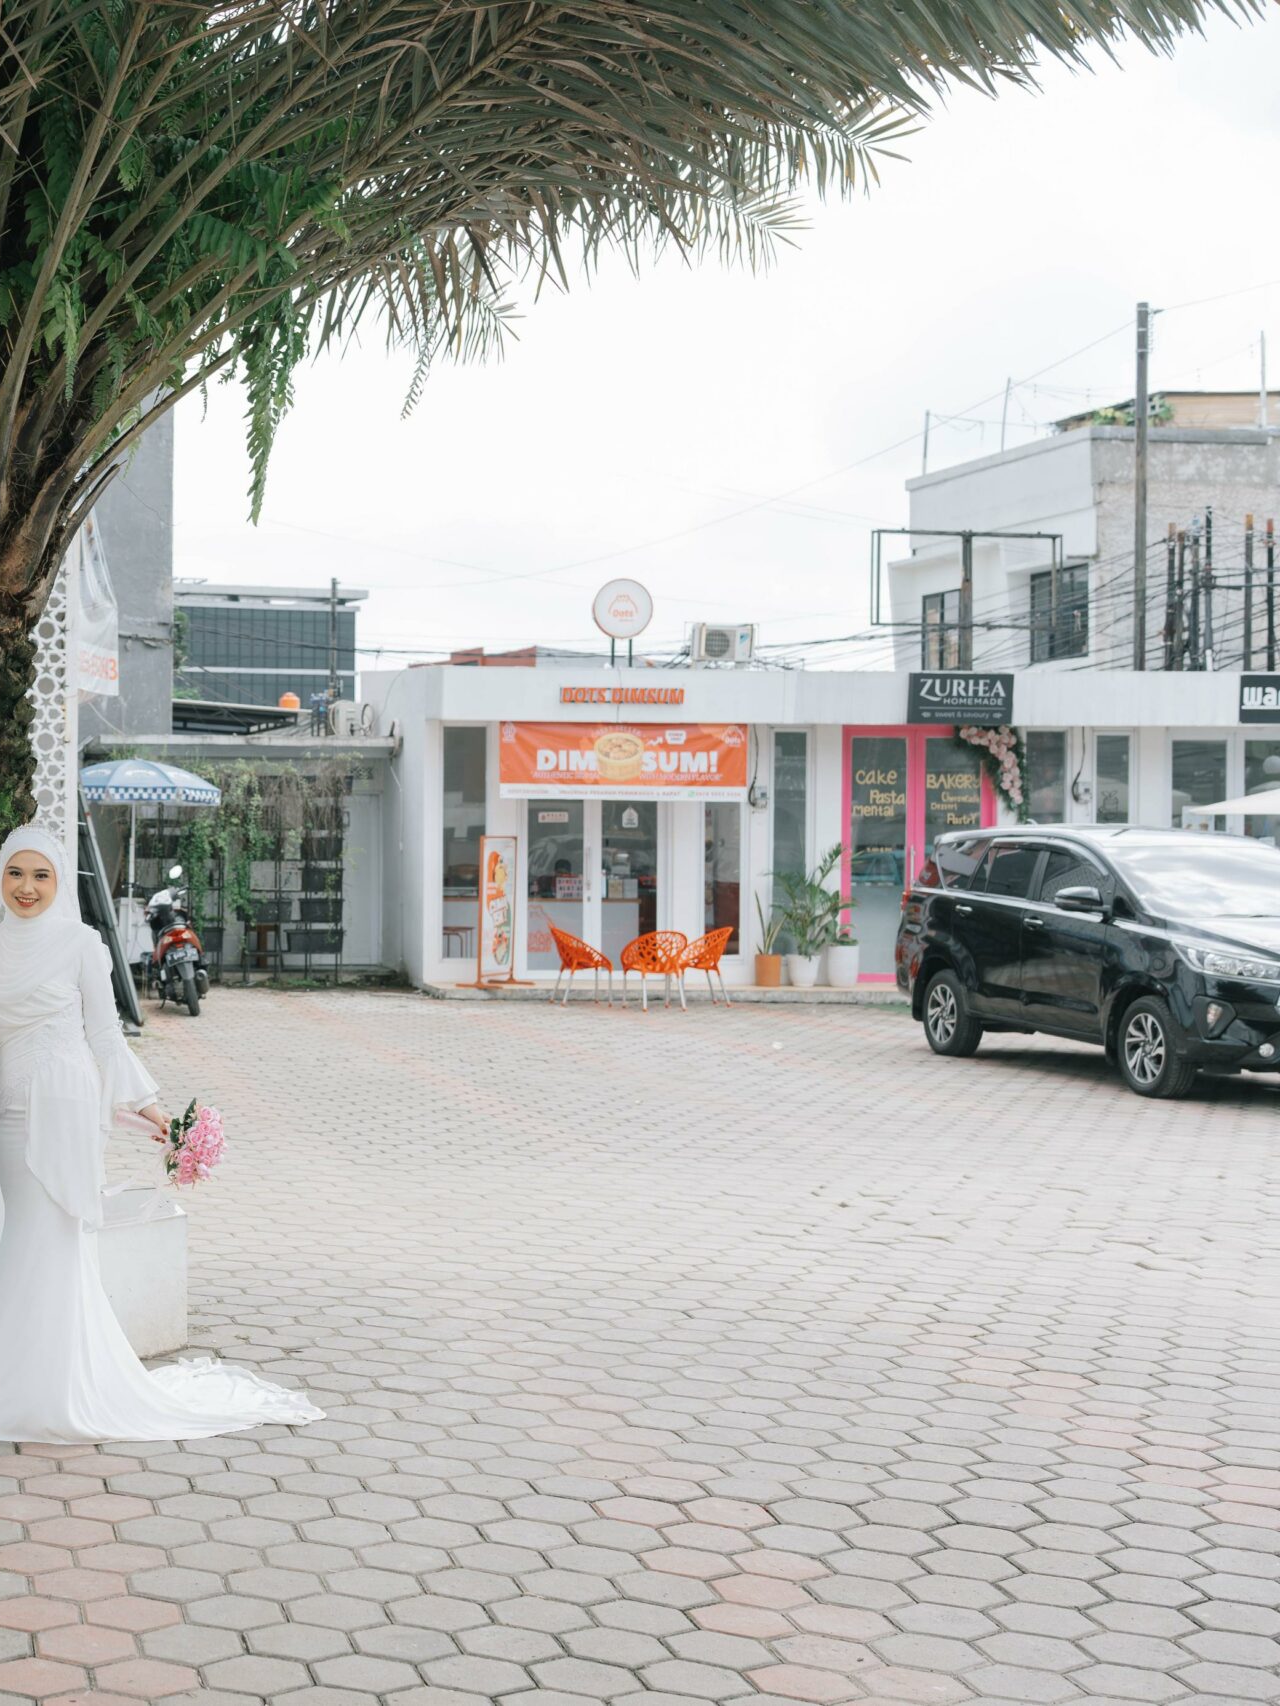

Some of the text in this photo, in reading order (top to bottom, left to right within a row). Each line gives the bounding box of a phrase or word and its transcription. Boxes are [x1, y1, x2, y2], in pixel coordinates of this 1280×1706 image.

[562, 687, 685, 704] DOTS DIMSUM
[919, 678, 1006, 701] ZURHEA
[1242, 686, 1280, 707] wa
[942, 697, 1004, 705] HOMEMADE
[536, 749, 718, 773] DIM SUM!
[855, 770, 898, 785] Cake
[870, 789, 905, 805] Pasta
